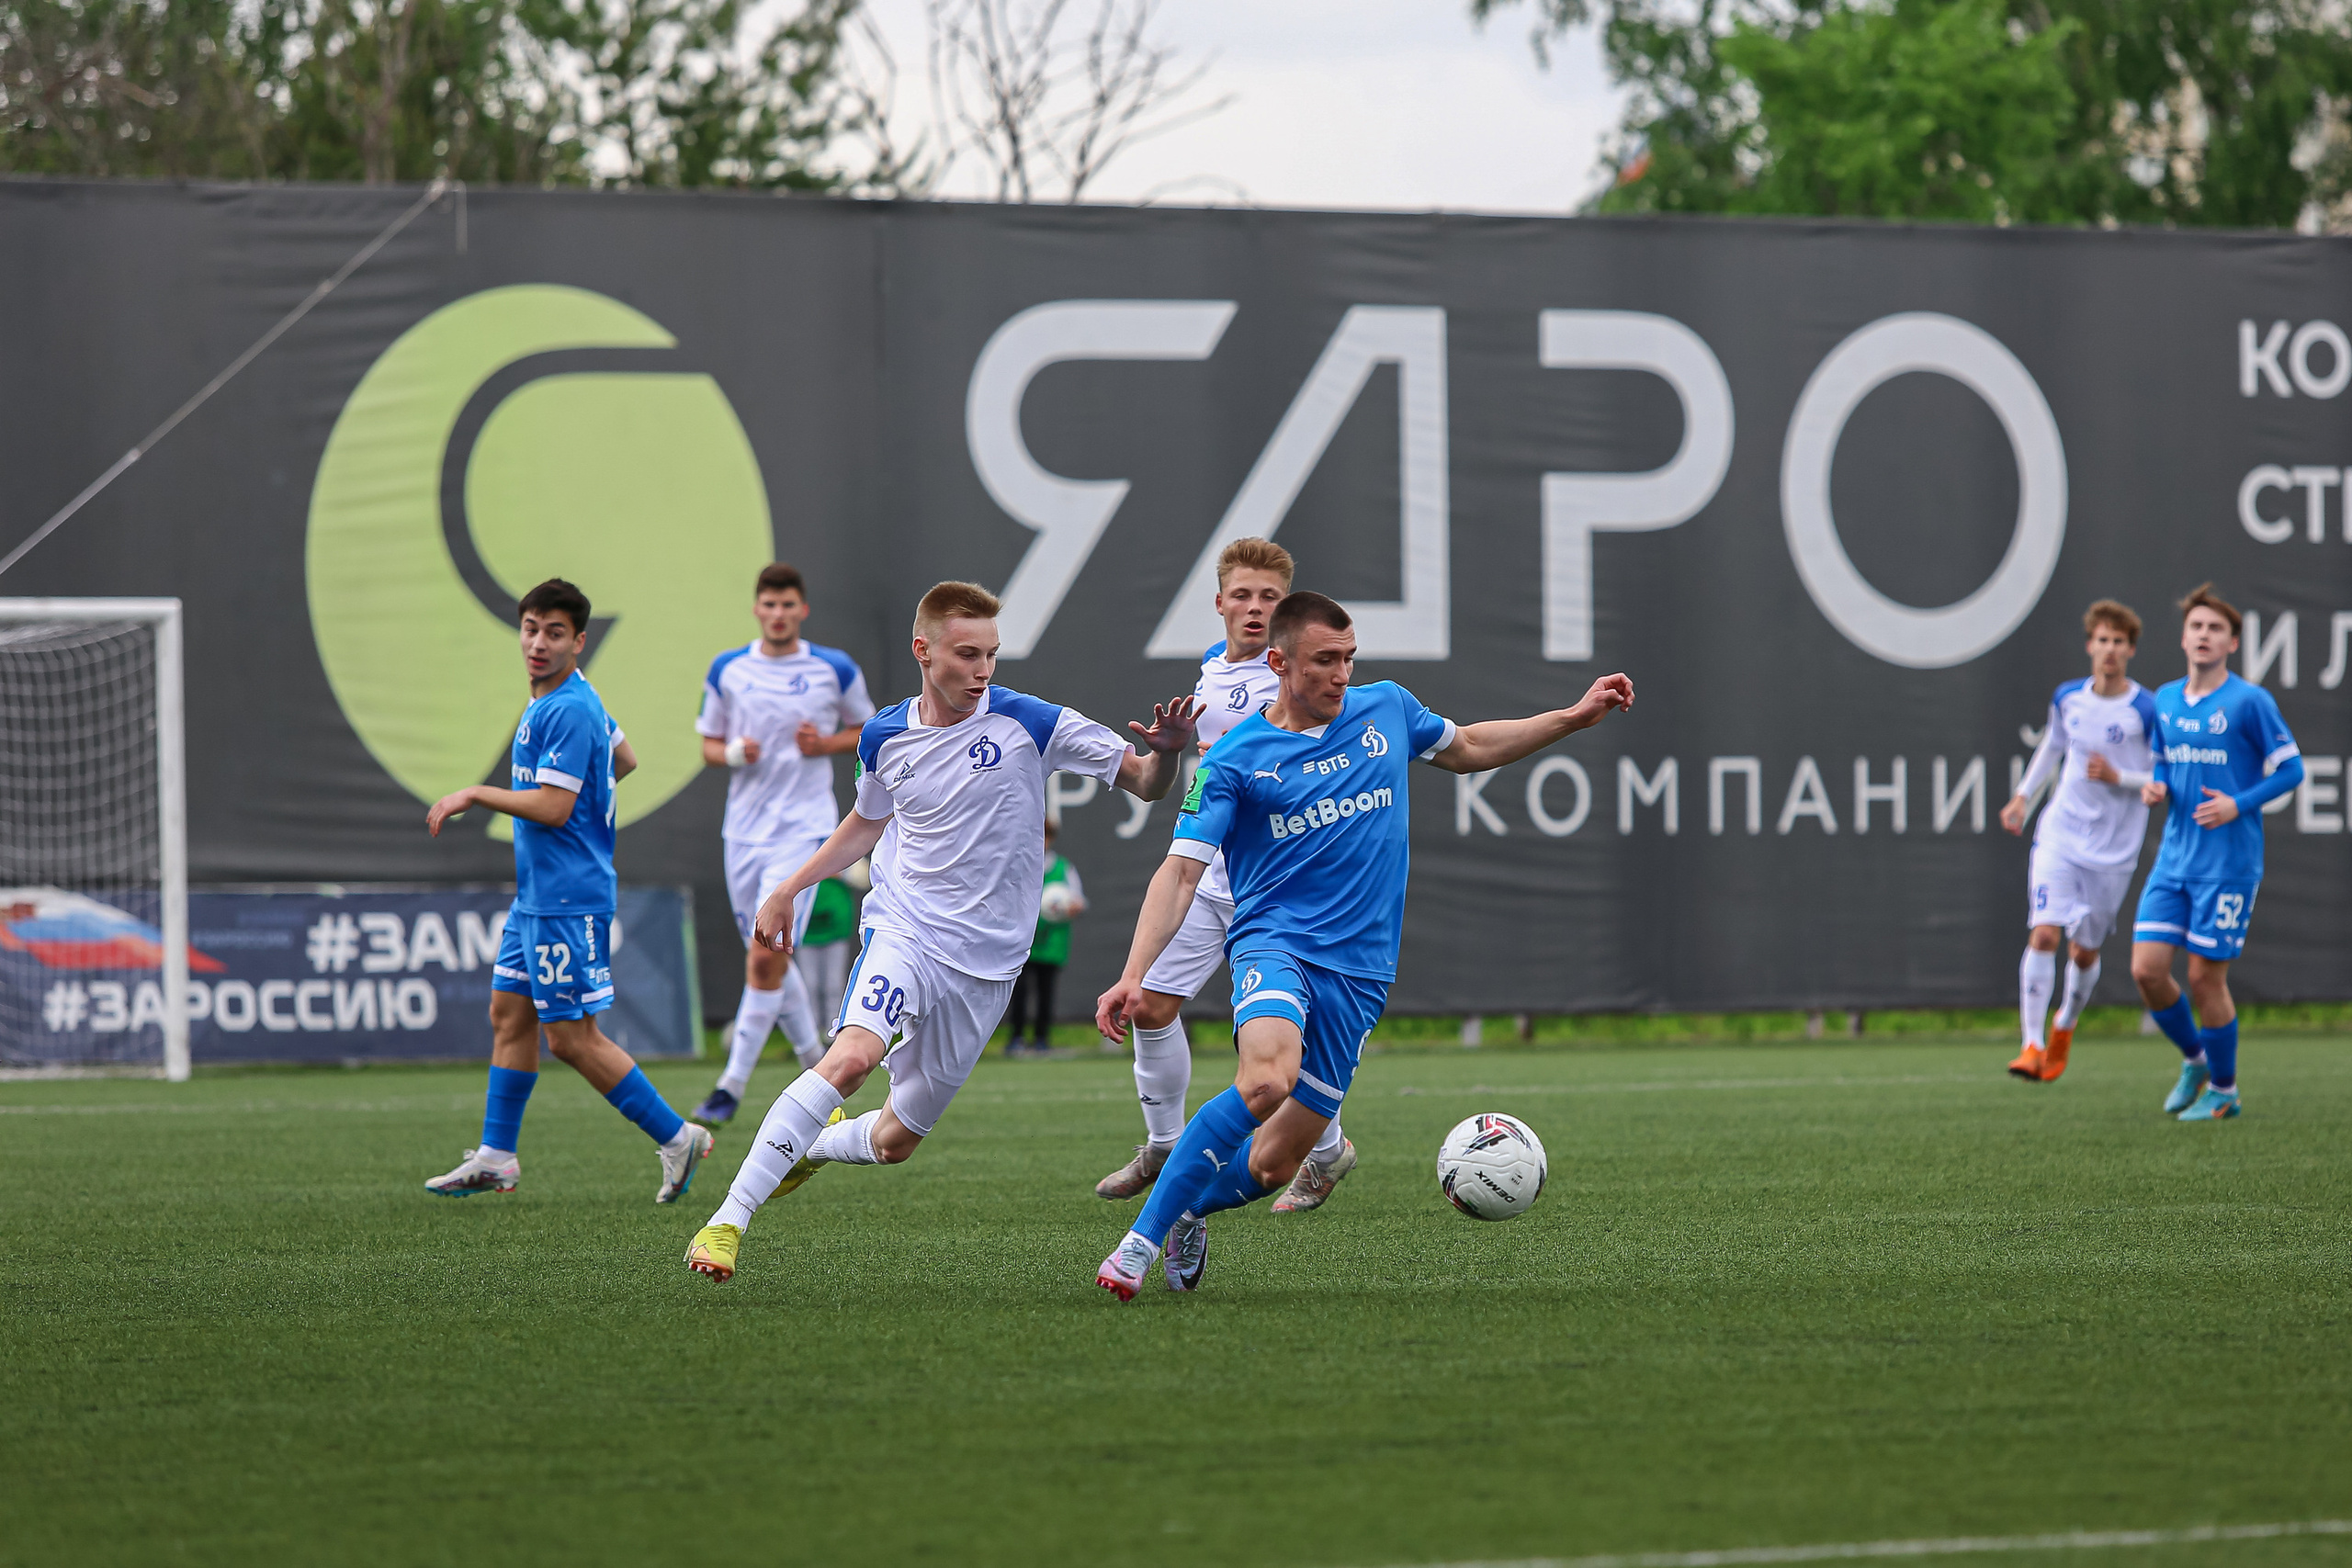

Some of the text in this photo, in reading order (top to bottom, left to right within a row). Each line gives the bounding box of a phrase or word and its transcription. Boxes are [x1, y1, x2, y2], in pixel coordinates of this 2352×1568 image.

[966, 299, 2068, 669] ЯДРО
[2237, 463, 2352, 544] СТ
[1317, 752, 1351, 776] ВТБ
[1269, 786, 1394, 840] BetBoom
[2215, 893, 2245, 931] 52
[306, 911, 623, 974] #ЗАМ
[535, 942, 574, 986] 32
[43, 978, 437, 1032] #ЗАРОССИЮ
[862, 975, 905, 1027] 30
[1474, 1170, 1517, 1204] DEMIX
